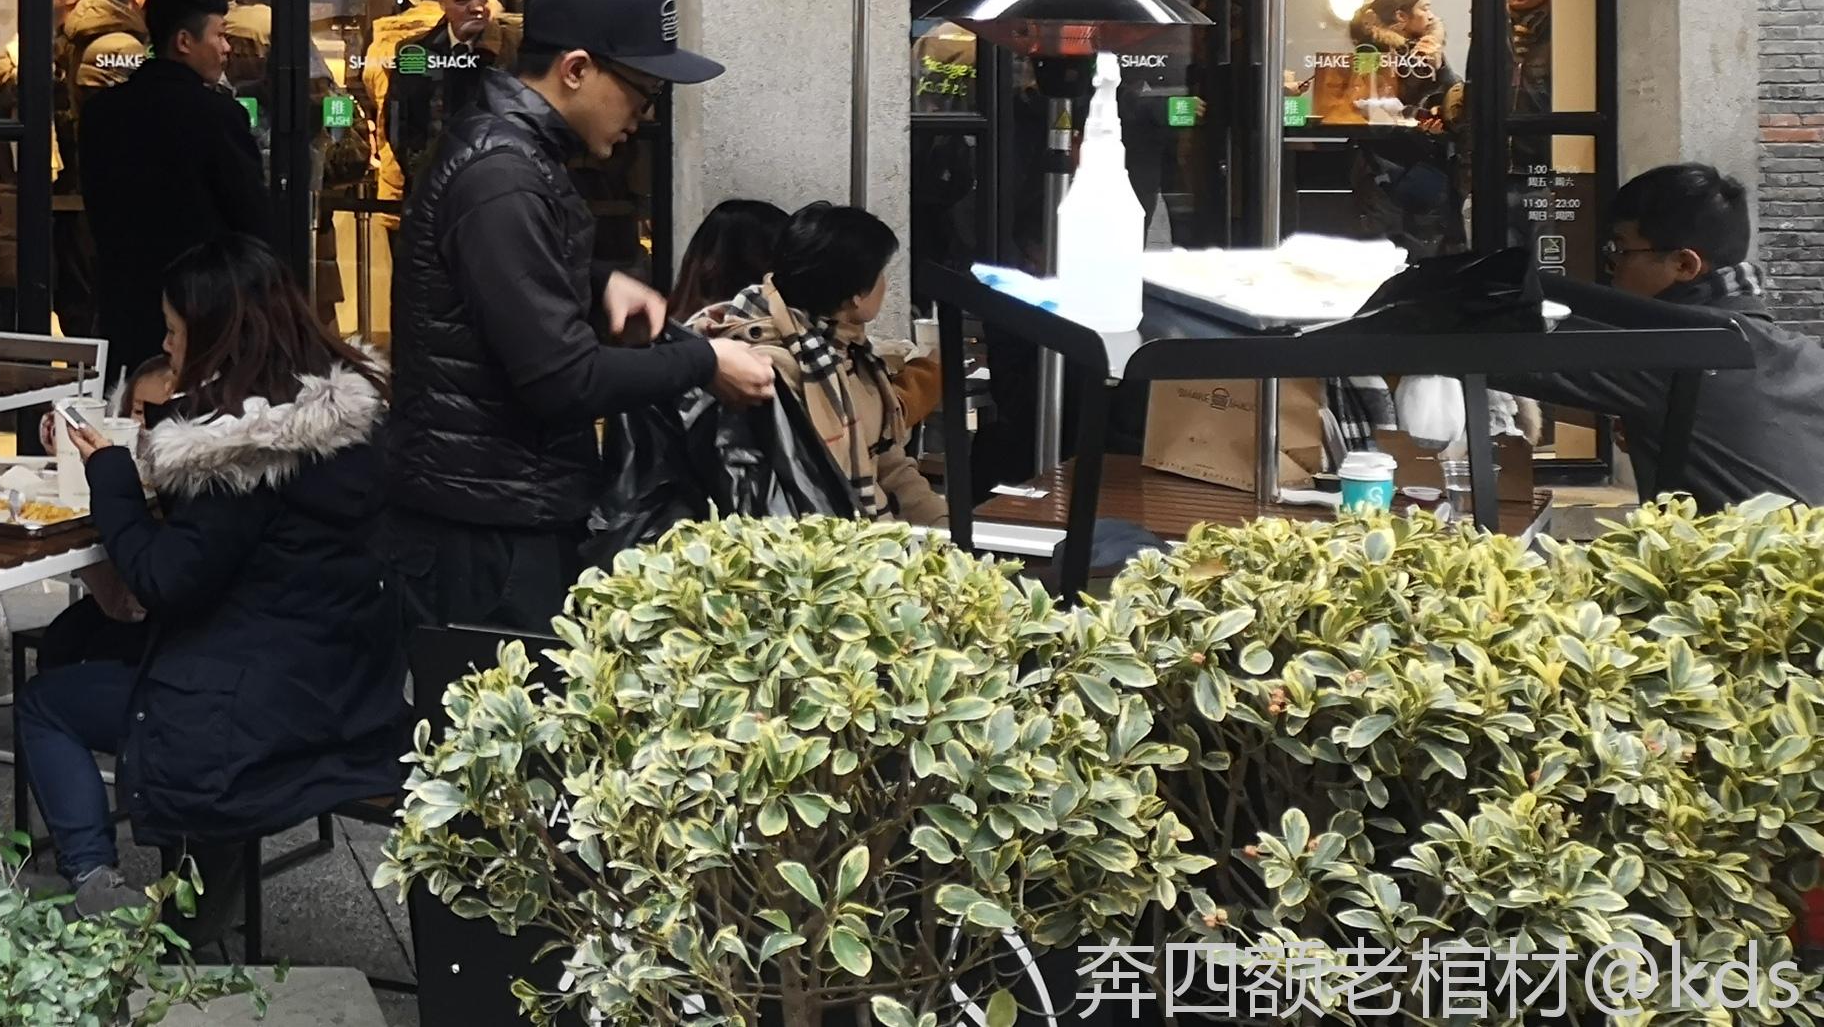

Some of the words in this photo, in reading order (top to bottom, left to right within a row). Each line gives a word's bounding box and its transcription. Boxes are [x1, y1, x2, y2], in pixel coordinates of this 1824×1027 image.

[95, 53, 144, 68] SHAKE
[427, 55, 477, 69] SHACK
[1121, 54, 1166, 67] SHACK
[1304, 55, 1350, 68] SHAKE
[1379, 55, 1426, 68] SHACK
[326, 116, 351, 126] PUSH
[1283, 116, 1304, 126] USH
[1555, 198, 1581, 208] 23:00
